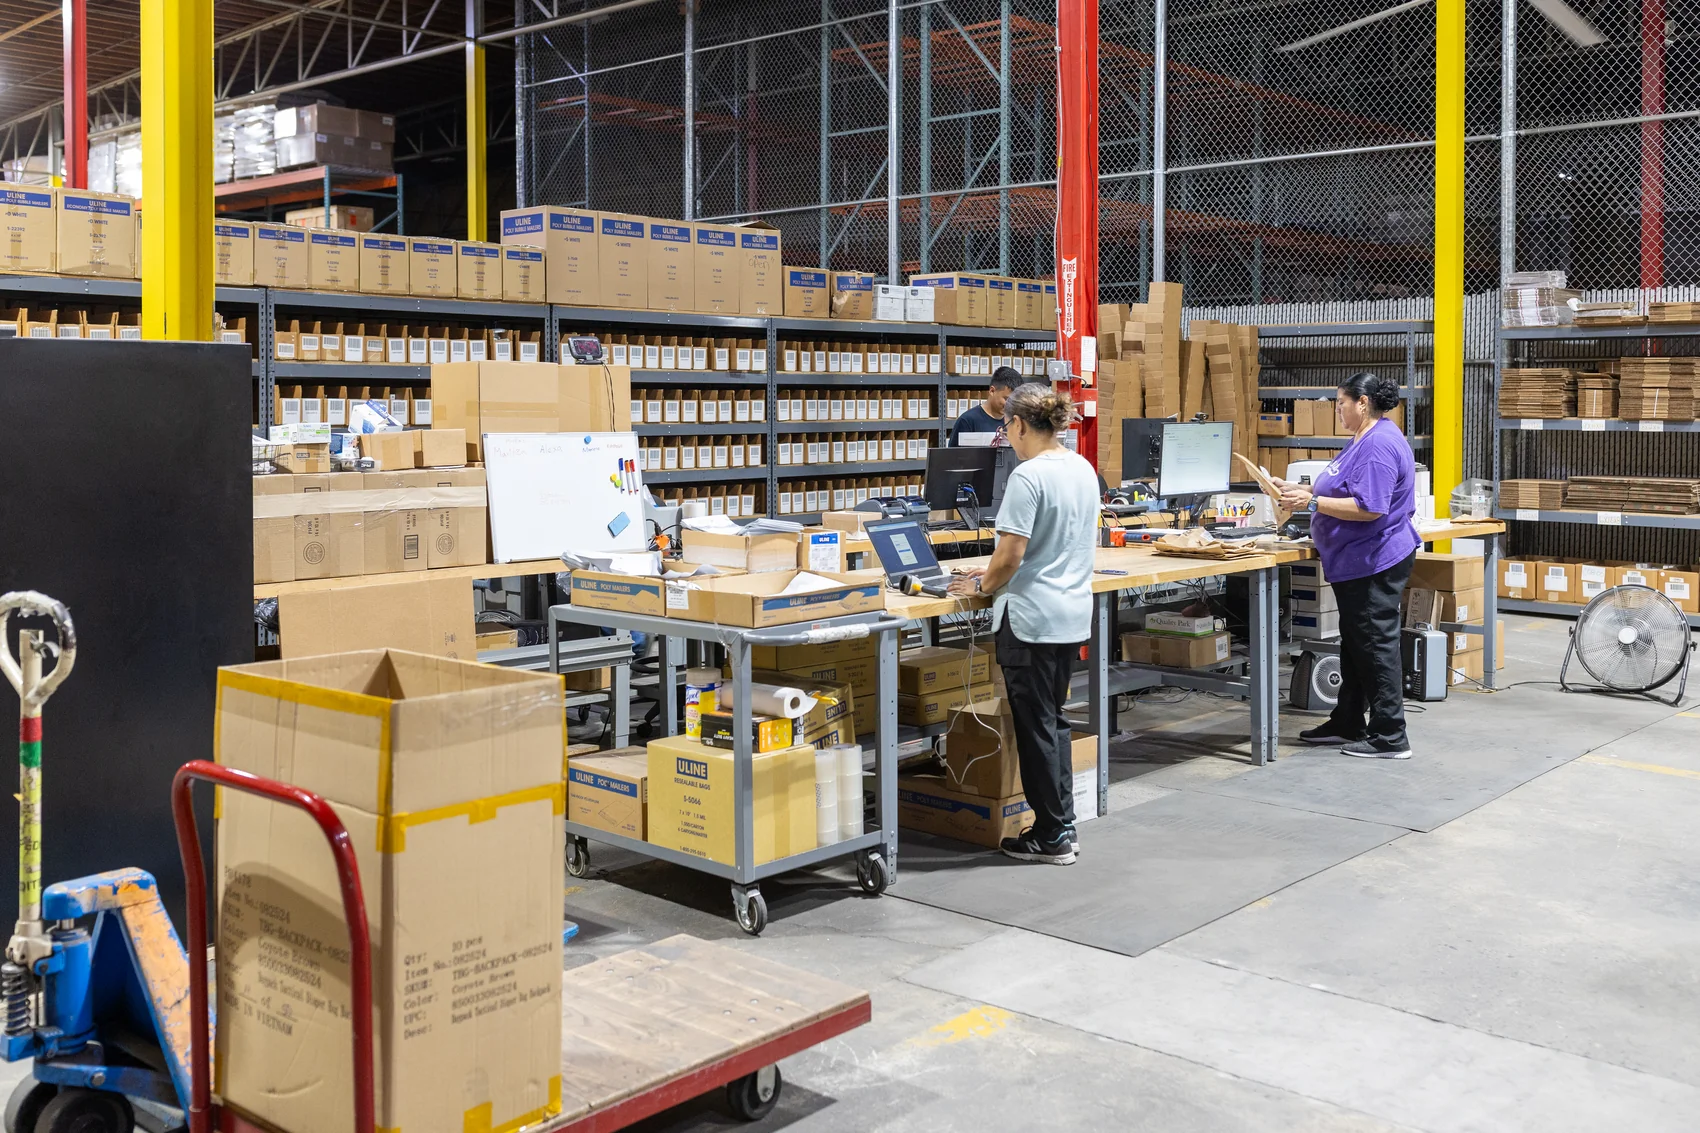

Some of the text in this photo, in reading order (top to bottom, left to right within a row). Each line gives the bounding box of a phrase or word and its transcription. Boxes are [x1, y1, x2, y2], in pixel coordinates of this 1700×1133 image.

[515, 217, 531, 226] ULINE
[563, 216, 580, 224] ULINE
[1063, 264, 1076, 272] FIRE
[580, 581, 597, 589] ULINE
[790, 597, 807, 606] ULINE
[827, 703, 846, 718] ULINE
[678, 760, 706, 777] ULINE
[576, 772, 594, 784] ULINE
[610, 781, 629, 792] MAILERS
[674, 777, 698, 788] RESEALABLE
[684, 795, 701, 805] S-5066
[1006, 804, 1021, 815] ULINE
[404, 953, 427, 966] Qty:
[405, 968, 428, 981] Item
[404, 969, 515, 1011] Color: Coyote Brown
[244, 1003, 253, 1016] IN
[256, 1010, 293, 1036] VIETNAM
[404, 1012, 427, 1026] UPC:
[404, 1024, 432, 1040] Desc:
